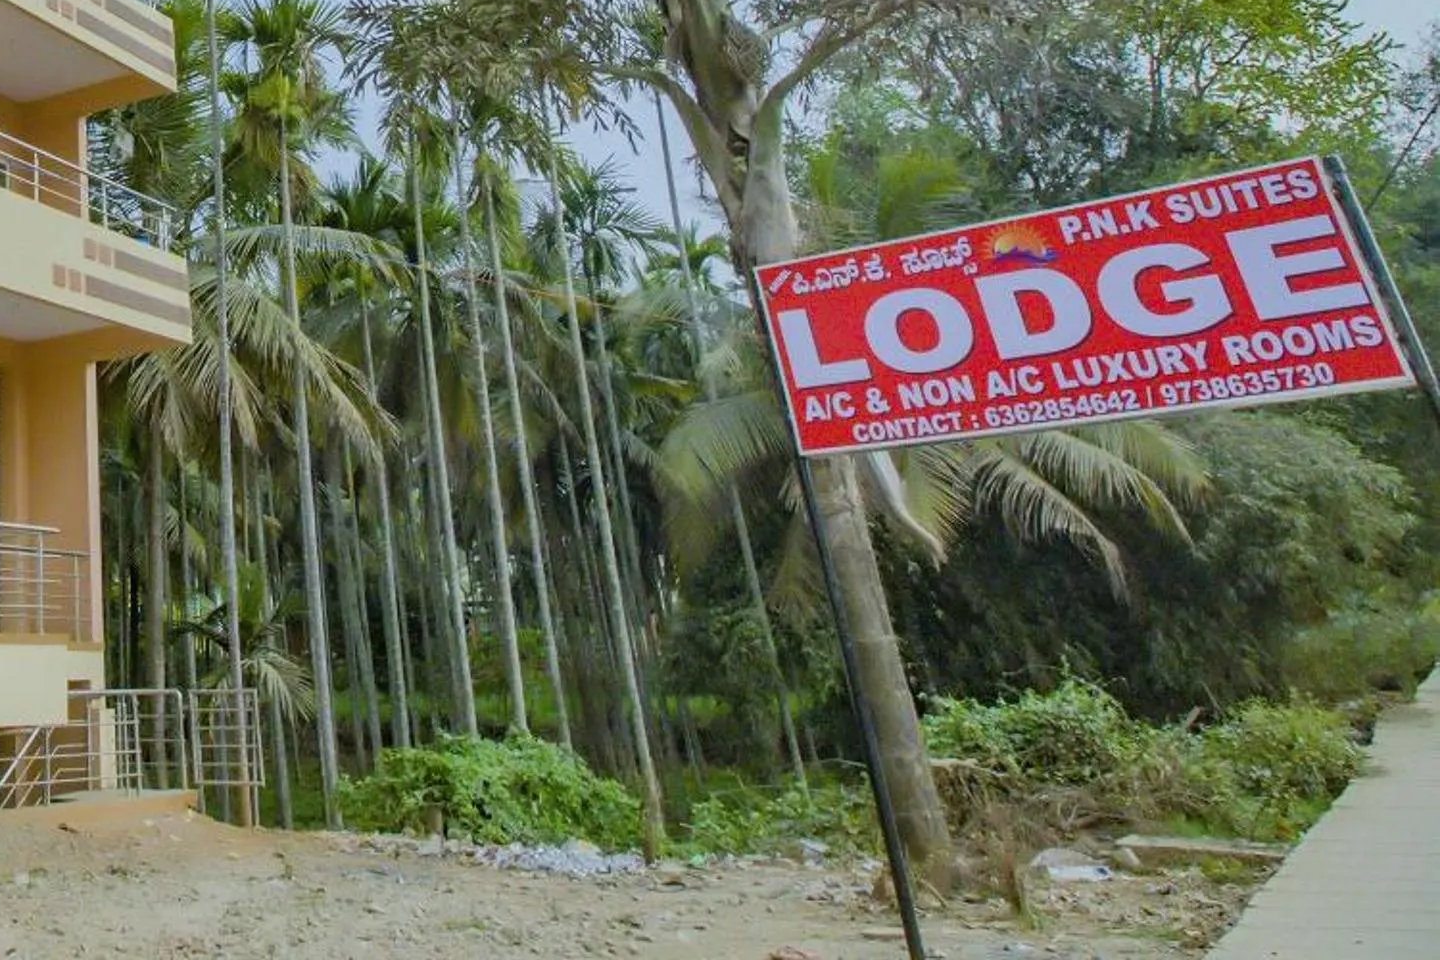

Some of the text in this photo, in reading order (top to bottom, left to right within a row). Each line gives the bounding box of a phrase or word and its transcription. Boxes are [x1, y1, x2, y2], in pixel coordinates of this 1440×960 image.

[1059, 169, 1319, 244] P.N.K SUITES
[777, 214, 1371, 389] LODGE
[805, 315, 1384, 422] A/C & NON A/C LUXURY ROOMS
[852, 412, 962, 443] CONTACT
[984, 391, 1140, 428] 6362854642
[1160, 362, 1334, 406] 9738635730
